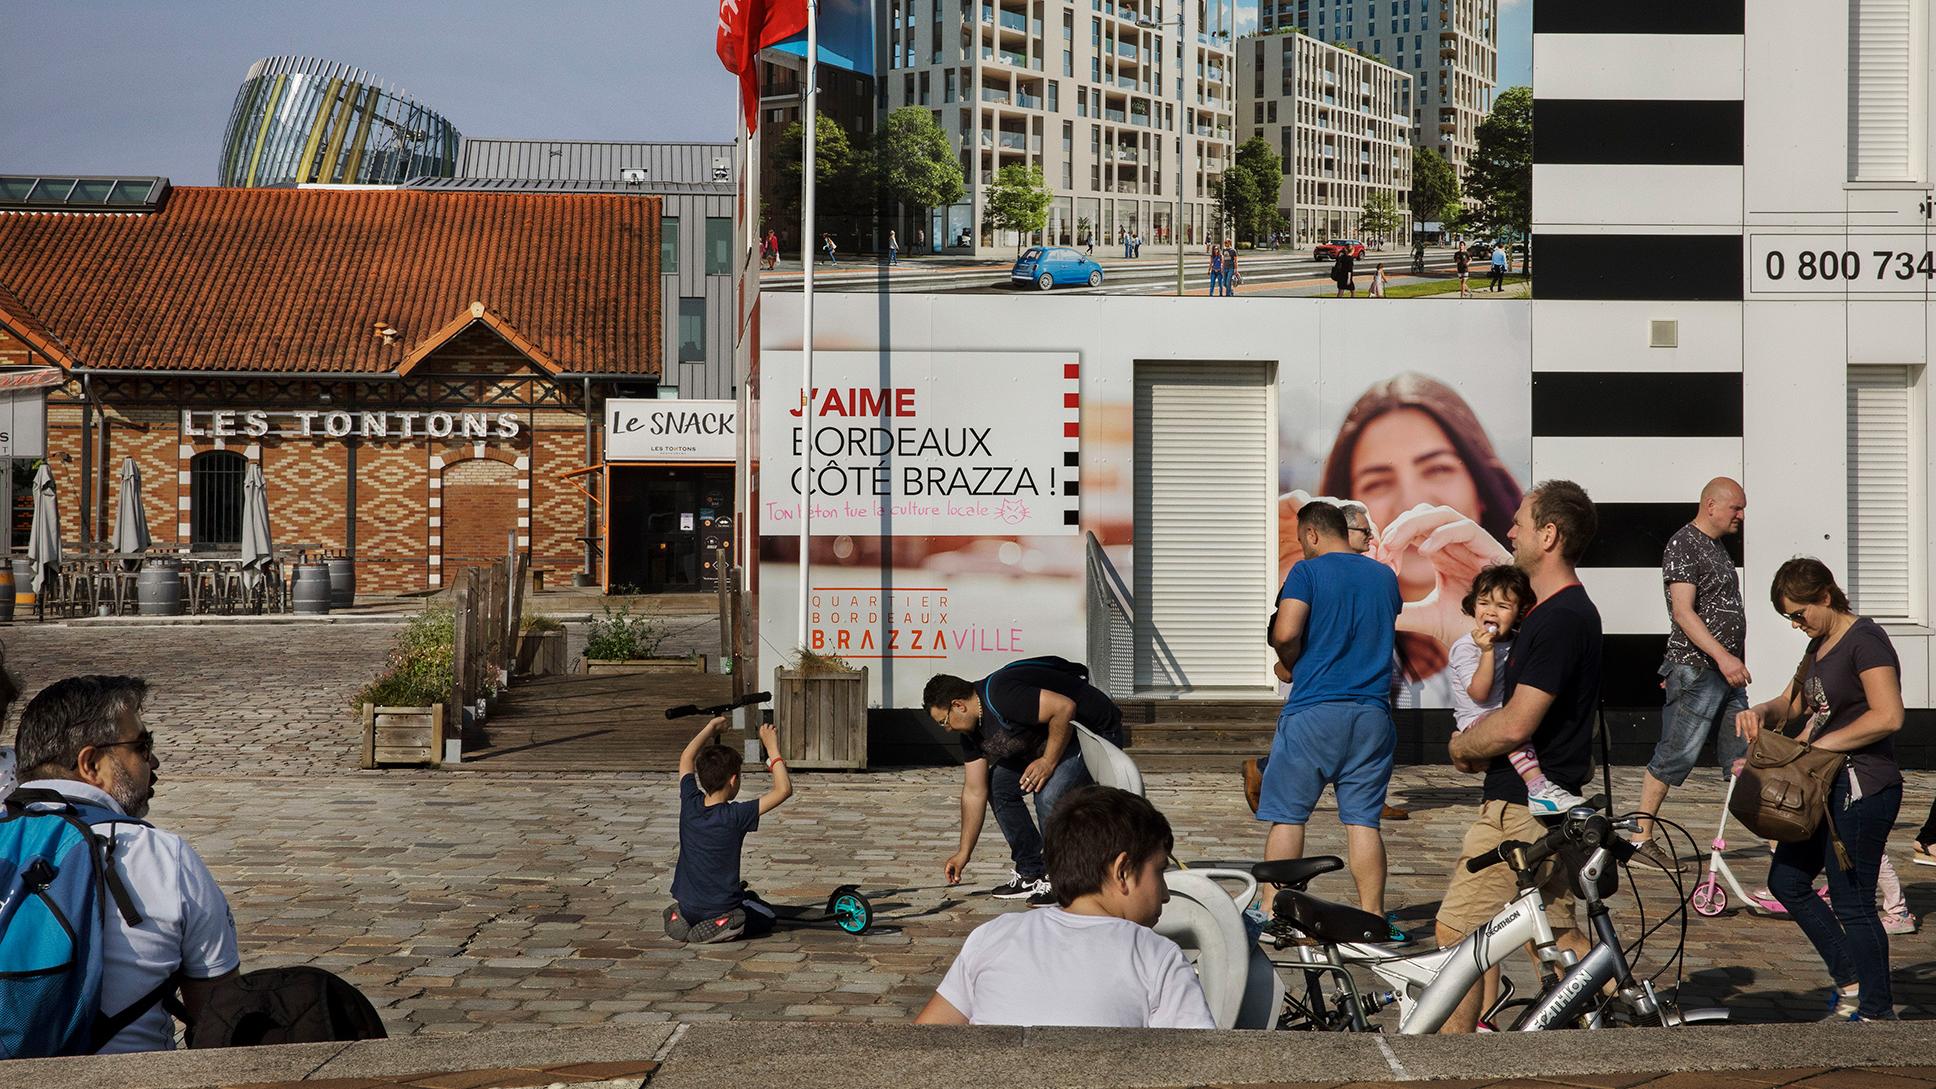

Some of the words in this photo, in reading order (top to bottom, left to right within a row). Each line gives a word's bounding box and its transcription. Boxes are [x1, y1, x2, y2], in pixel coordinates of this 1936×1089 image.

[1766, 250, 1785, 281] 0
[1798, 250, 1861, 281] 800
[1873, 250, 1936, 280] 734
[789, 387, 917, 418] J'AIME
[182, 409, 269, 437] LES
[294, 409, 520, 438] TONTONS
[612, 410, 646, 434] Le
[650, 411, 735, 436] SNACK
[792, 426, 993, 457] BORDEAUX
[791, 459, 892, 496] CÔTÉ
[903, 466, 1040, 496] BRAZZA
[1050, 466, 1057, 496] !
[844, 501, 868, 517] tue
[873, 500, 887, 517] la
[890, 501, 940, 516] culture
[946, 499, 990, 517] locale
[811, 595, 948, 608] QUARTIER
[811, 612, 948, 624] BORDEAUX
[811, 629, 948, 650] BRAZZA
[1485, 910, 1521, 938] DECATHLON
[1526, 967, 1593, 1031] ECATHLON
